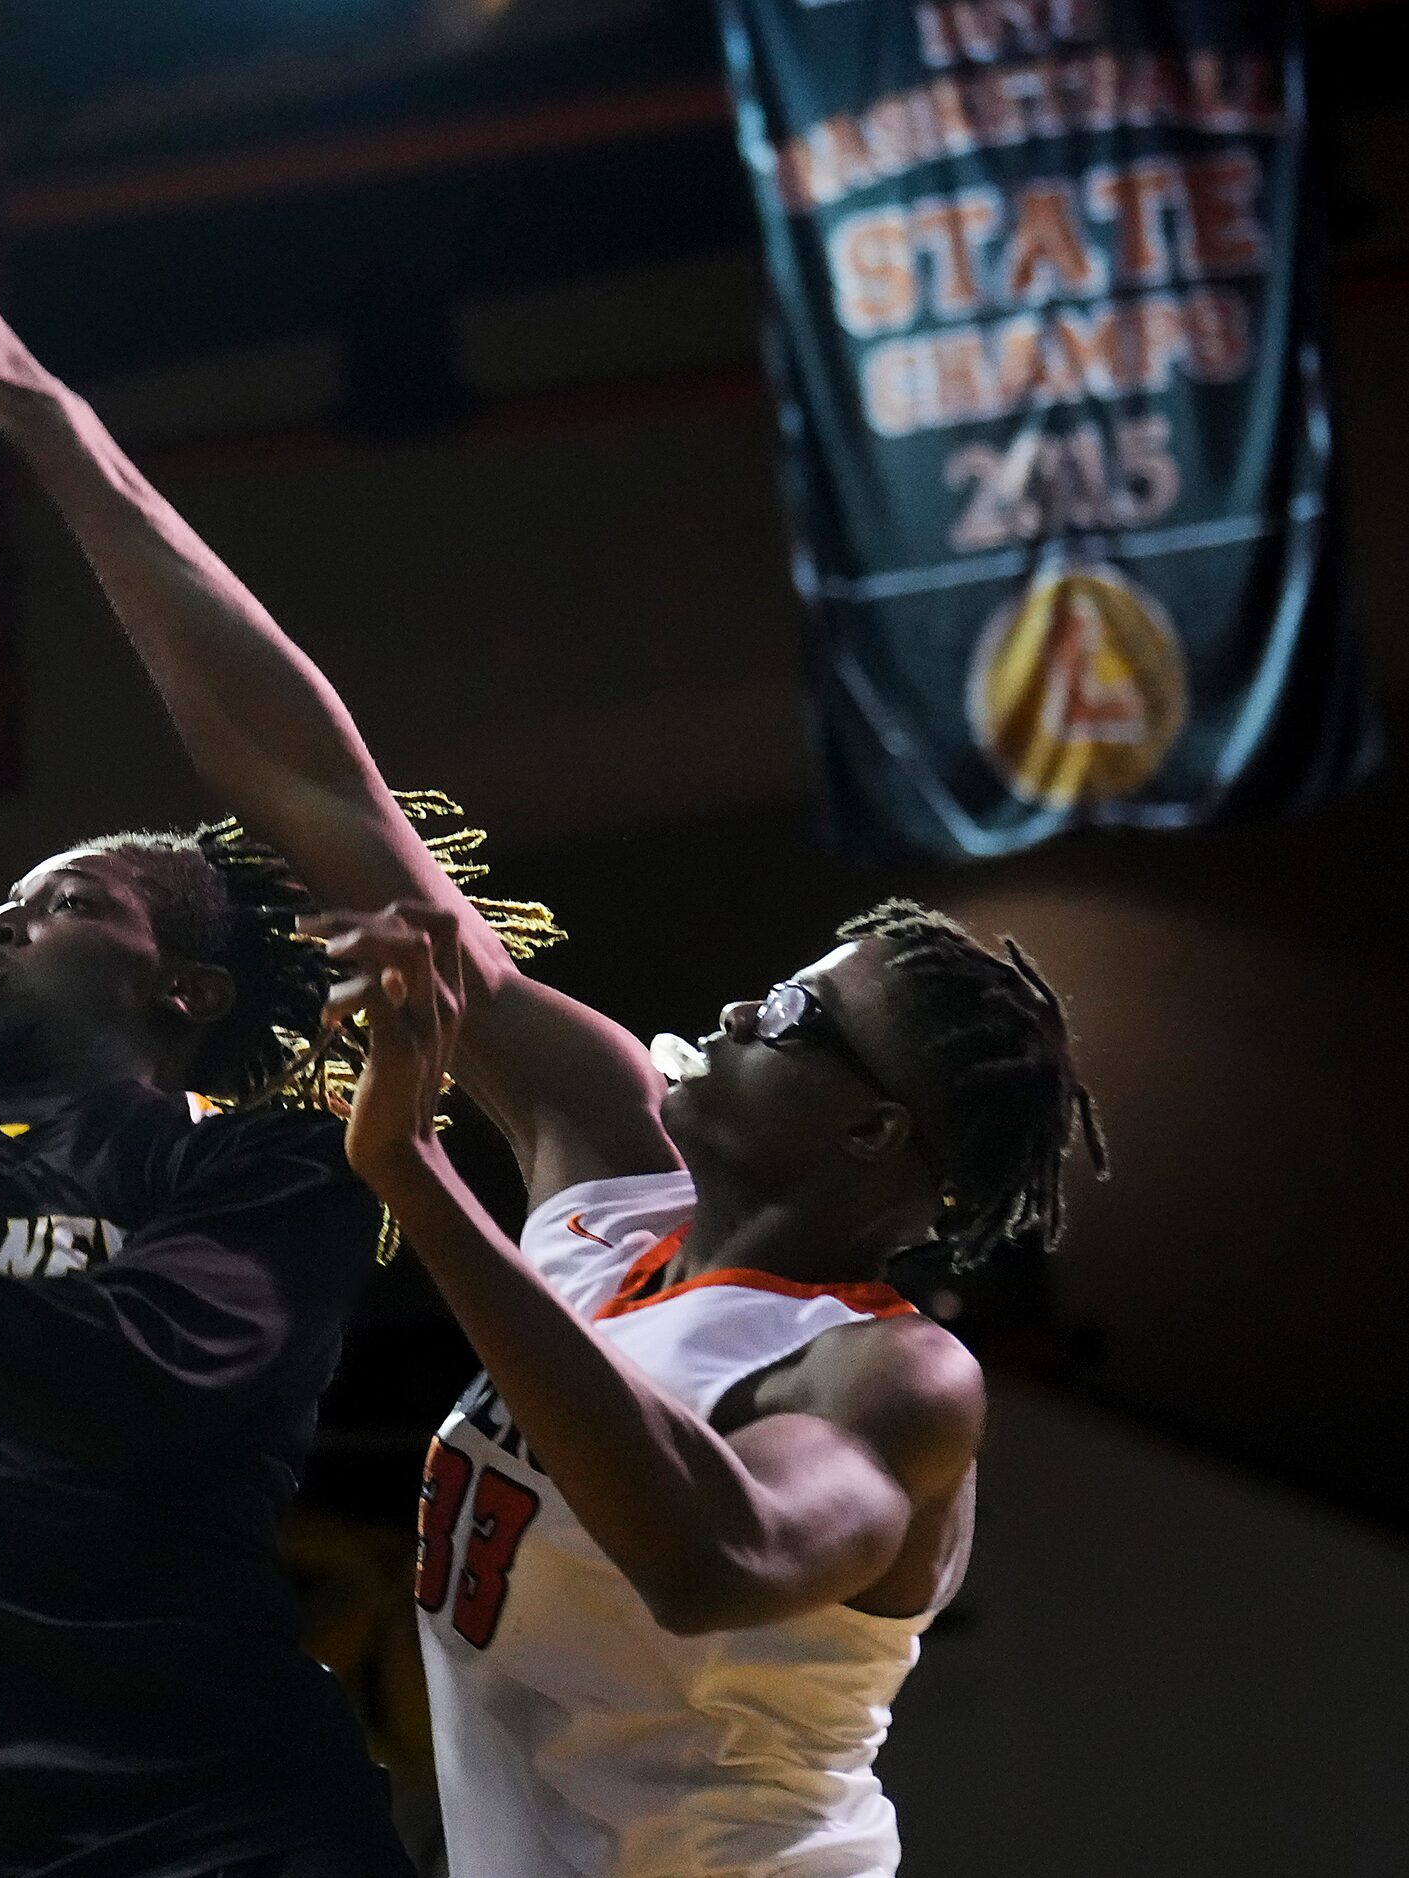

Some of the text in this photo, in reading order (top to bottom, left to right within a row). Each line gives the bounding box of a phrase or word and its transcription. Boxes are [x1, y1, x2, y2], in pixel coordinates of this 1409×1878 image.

[829, 146, 1264, 337] STATE
[860, 286, 1252, 437] CHAMPS
[414, 1433, 538, 1650] 33
